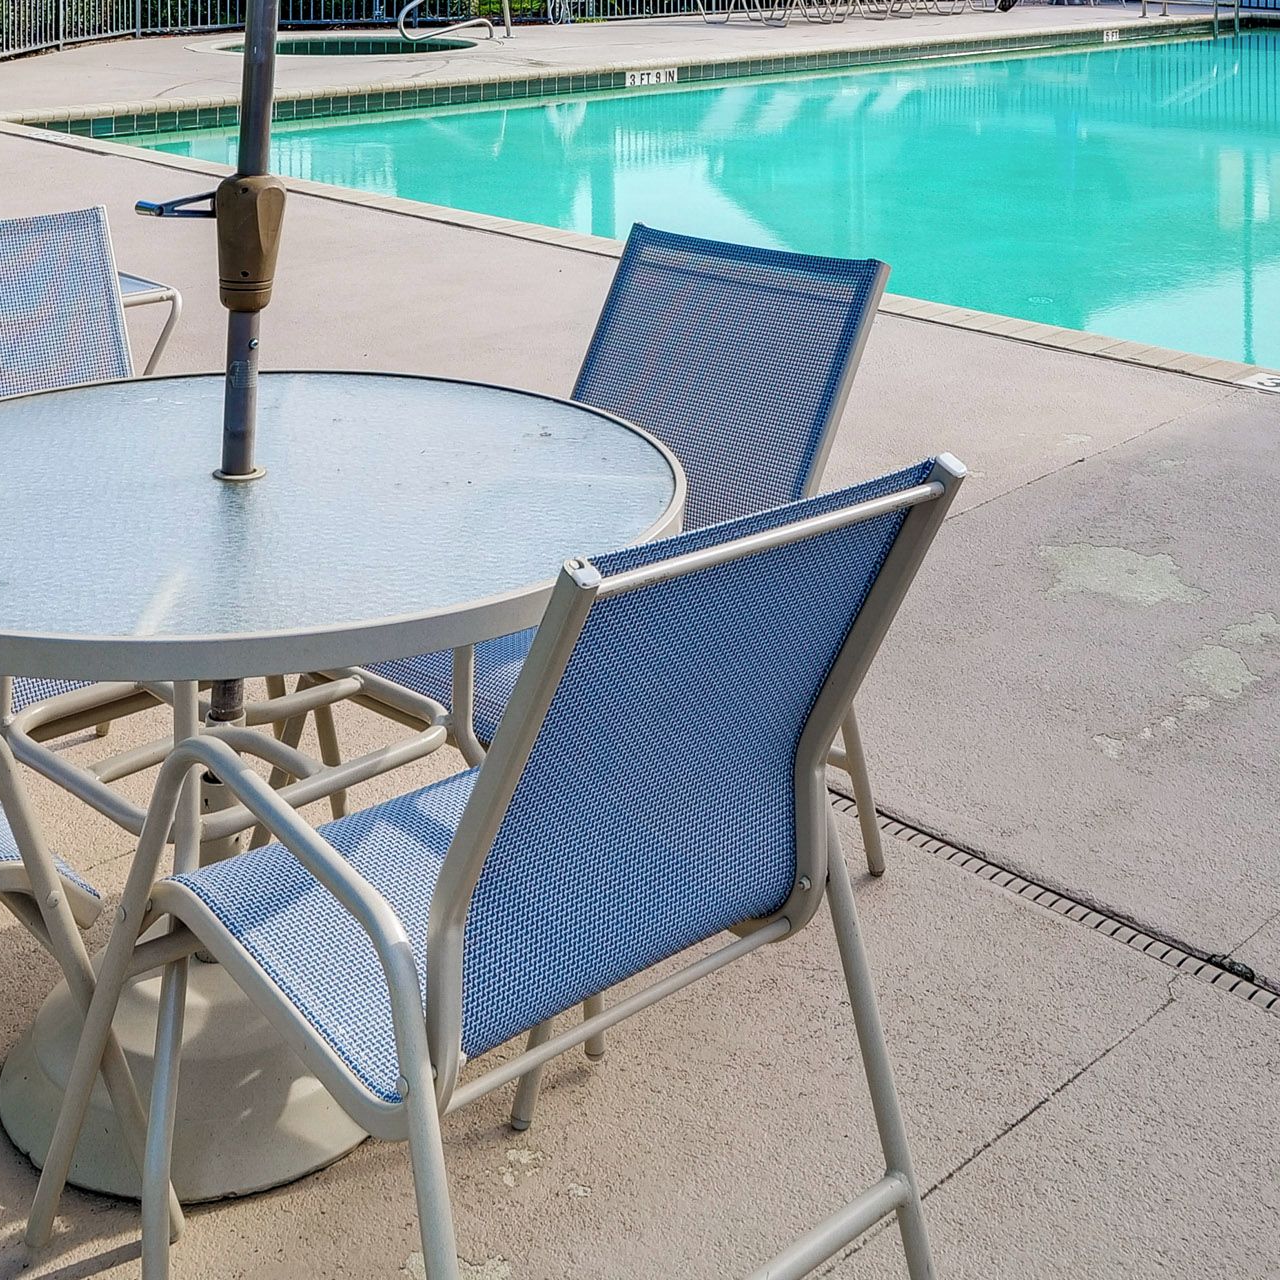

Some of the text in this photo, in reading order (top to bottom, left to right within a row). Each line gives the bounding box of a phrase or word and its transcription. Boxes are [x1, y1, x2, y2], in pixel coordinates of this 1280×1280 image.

[630, 70, 674, 86] 3 FT 9 IN
